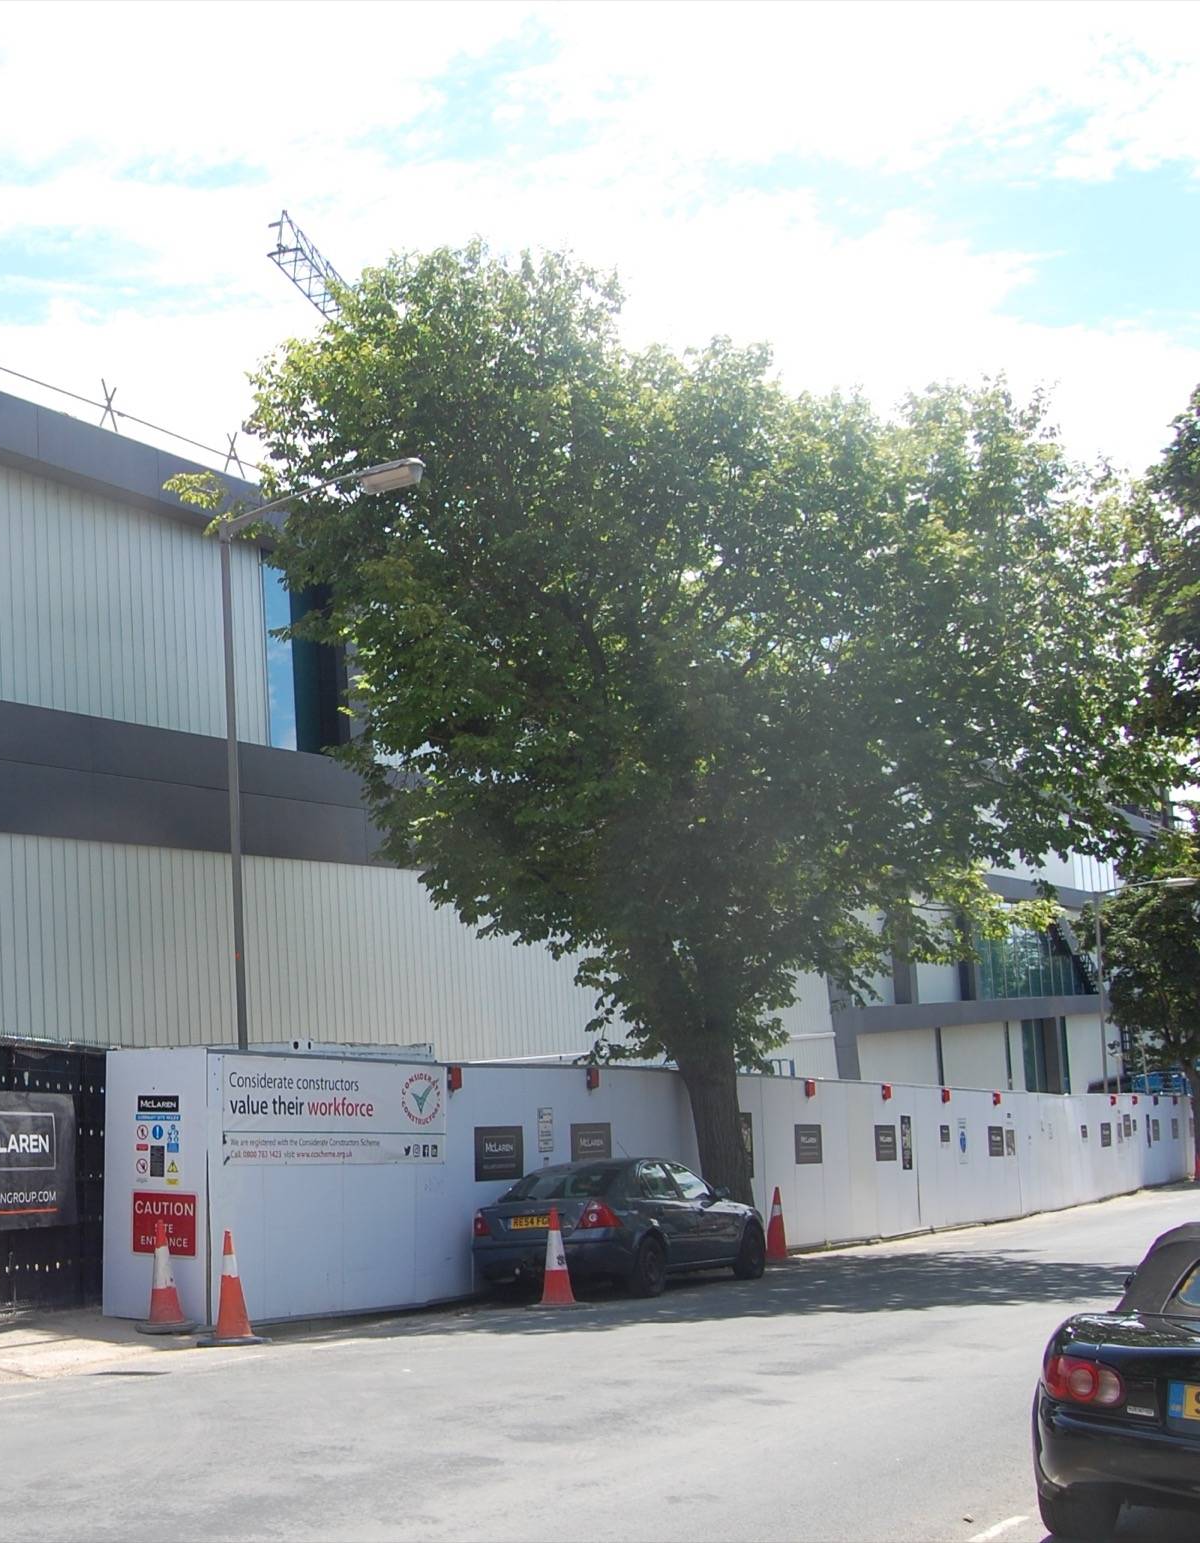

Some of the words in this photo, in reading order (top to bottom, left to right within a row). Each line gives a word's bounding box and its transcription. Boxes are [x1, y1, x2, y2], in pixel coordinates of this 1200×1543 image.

[229, 1071, 294, 1090] Considerate
[296, 1077, 359, 1092] constructors
[140, 1099, 177, 1108] McLAREN
[230, 1095, 269, 1115] value
[272, 1097, 304, 1116] their
[307, 1099, 374, 1117] workforce
[249, 1139, 276, 1147] registered
[134, 1200, 194, 1217] CAUTION
[140, 1235, 188, 1248] ENTNCE
